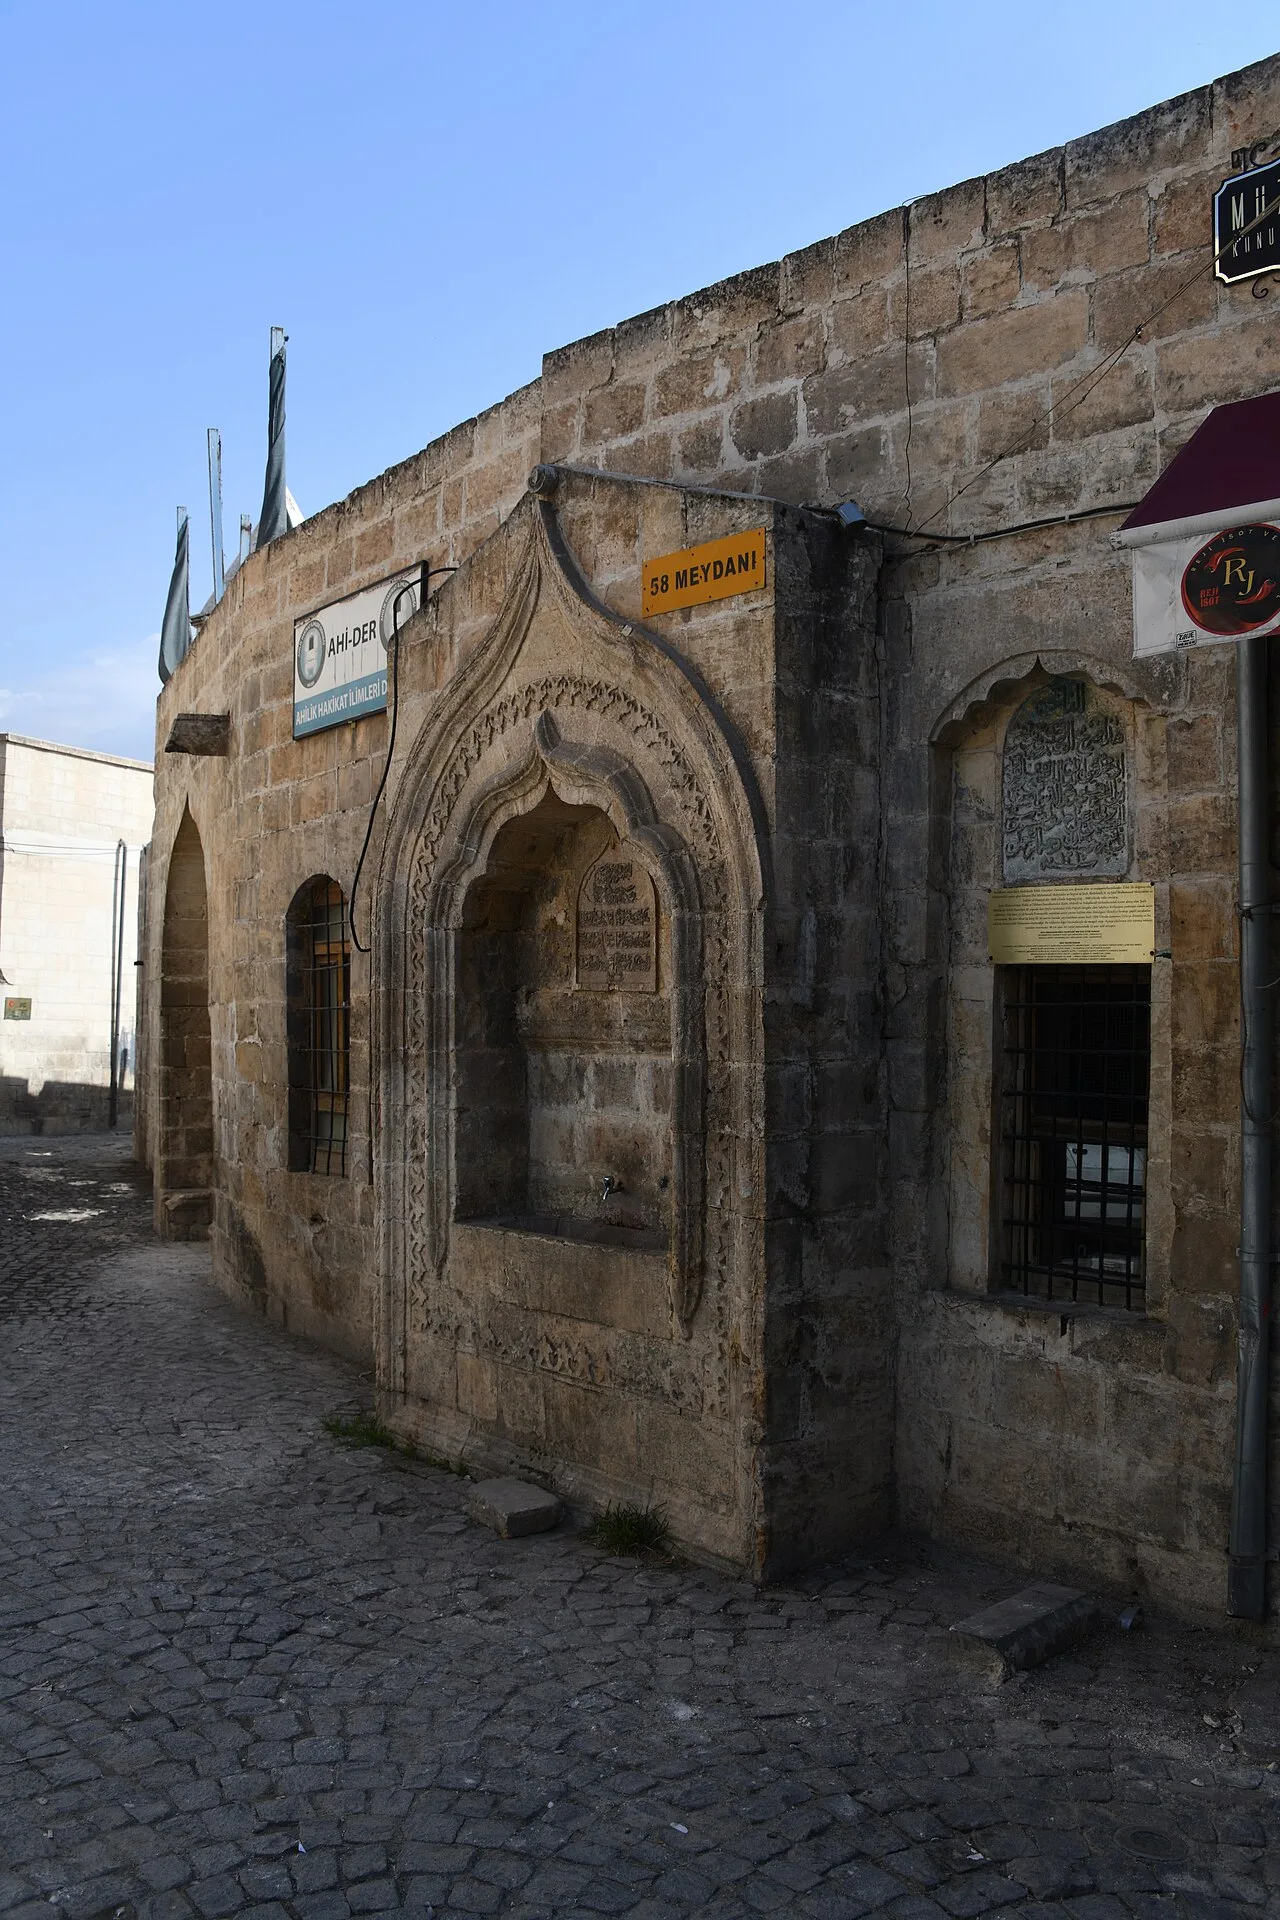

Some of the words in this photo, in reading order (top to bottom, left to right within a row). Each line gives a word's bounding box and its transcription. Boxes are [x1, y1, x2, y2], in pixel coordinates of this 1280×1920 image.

[1231, 180, 1280, 231] MÜ
[650, 574, 669, 597] 58
[675, 550, 756, 590] MEYDANI
[328, 619, 377, 658] AHİ-DER
[296, 704, 317, 725] AHİLİK
[317, 693, 349, 717] HAKİKAT
[349, 681, 381, 707] İLİMLERİ
